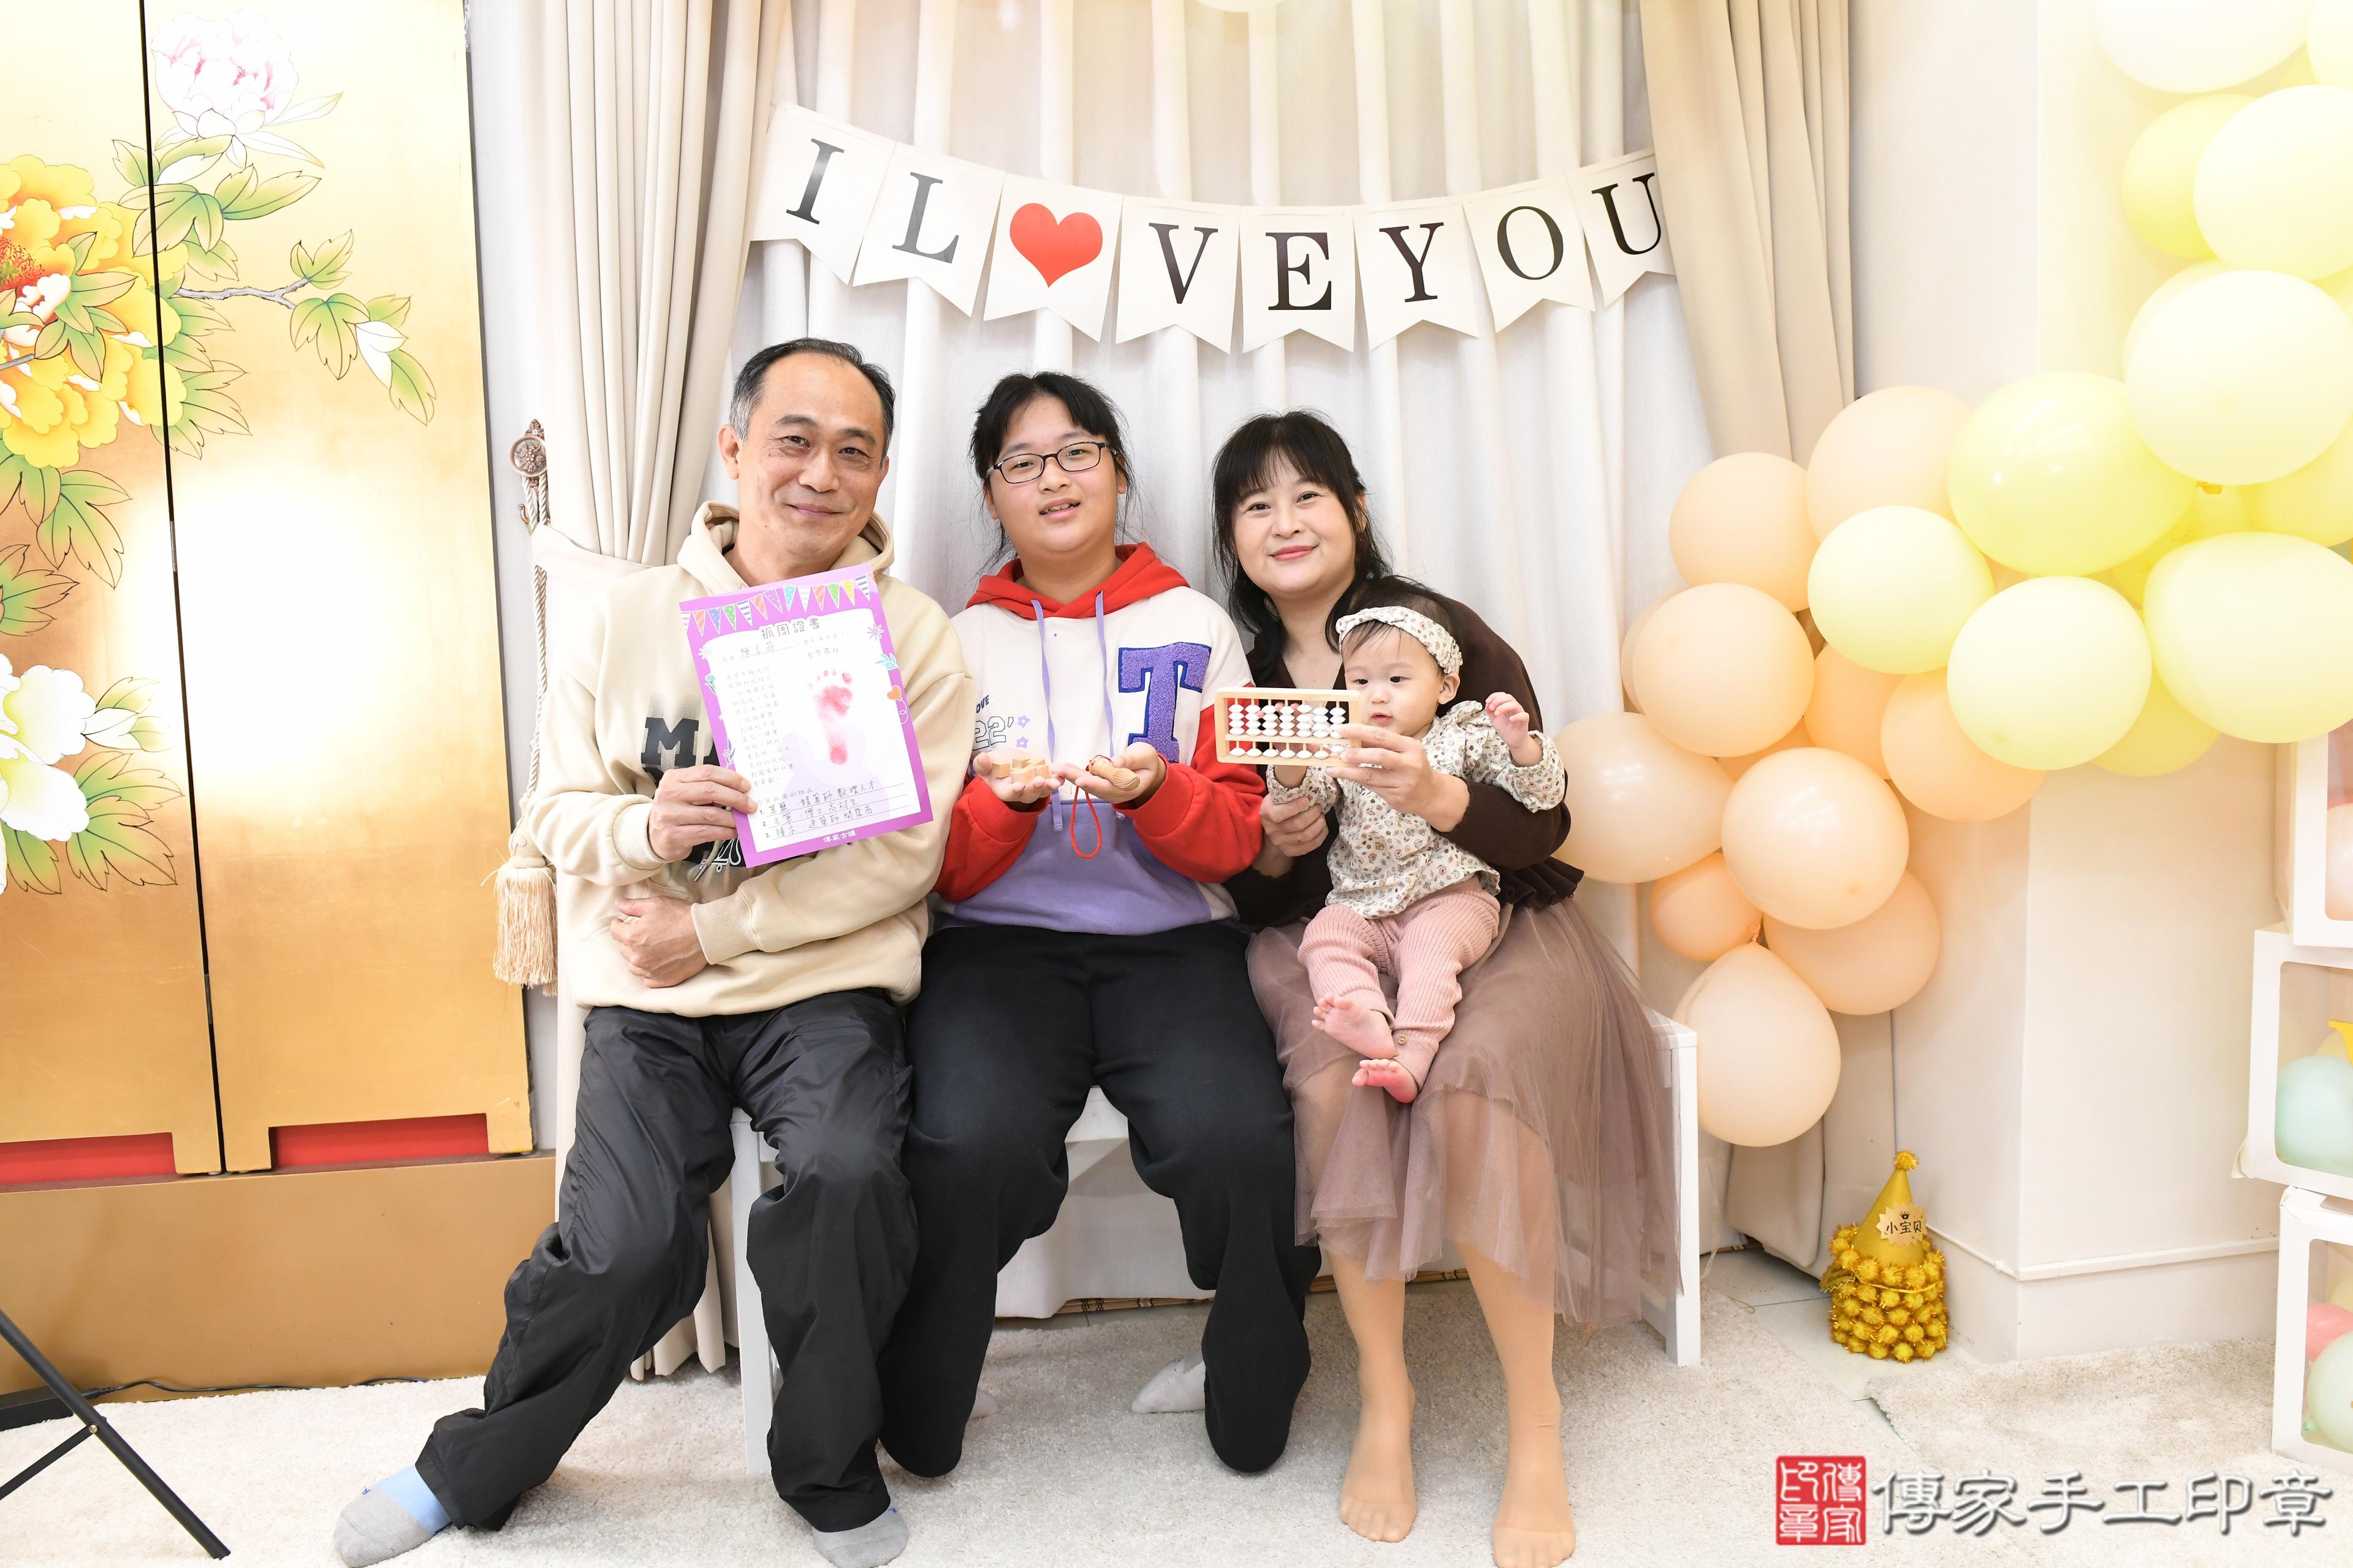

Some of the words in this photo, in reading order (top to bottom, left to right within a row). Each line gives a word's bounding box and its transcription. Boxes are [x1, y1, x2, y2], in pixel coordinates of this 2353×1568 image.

[761, 618, 820, 639] 抓周證書
[974, 694, 989, 713] OVE
[1118, 642, 1212, 763] T
[1886, 1221, 1922, 1235] 小宝贝
